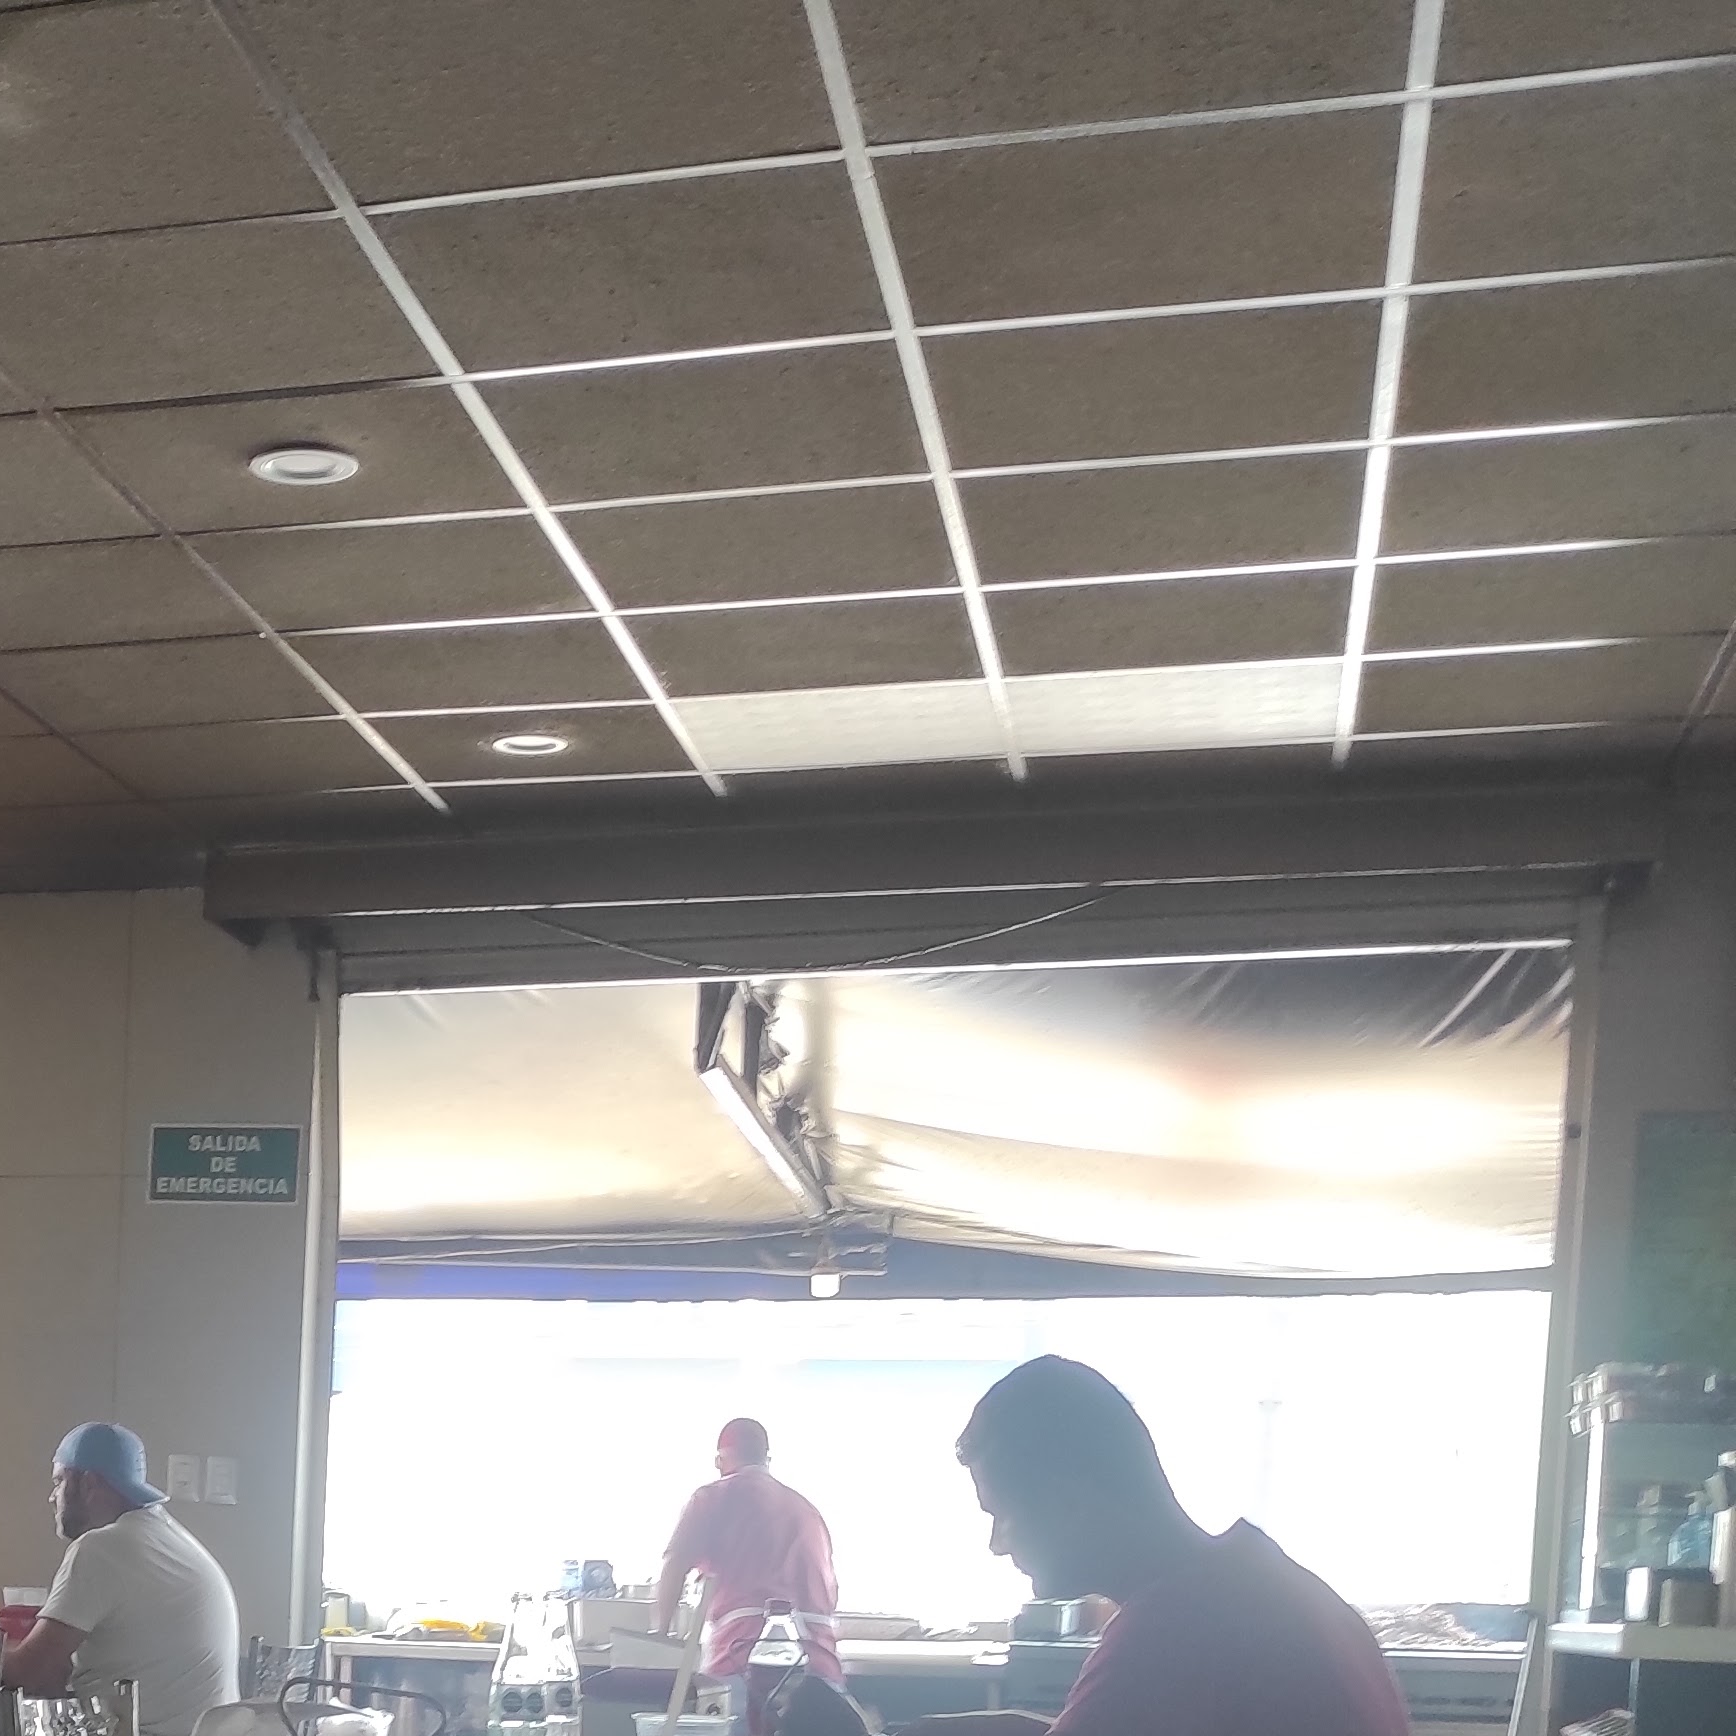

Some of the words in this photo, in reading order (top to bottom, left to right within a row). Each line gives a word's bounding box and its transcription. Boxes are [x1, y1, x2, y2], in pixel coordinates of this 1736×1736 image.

[188, 1134, 262, 1152] SALIDA
[209, 1156, 238, 1173] DE
[155, 1176, 289, 1195] EMERGENCIA
